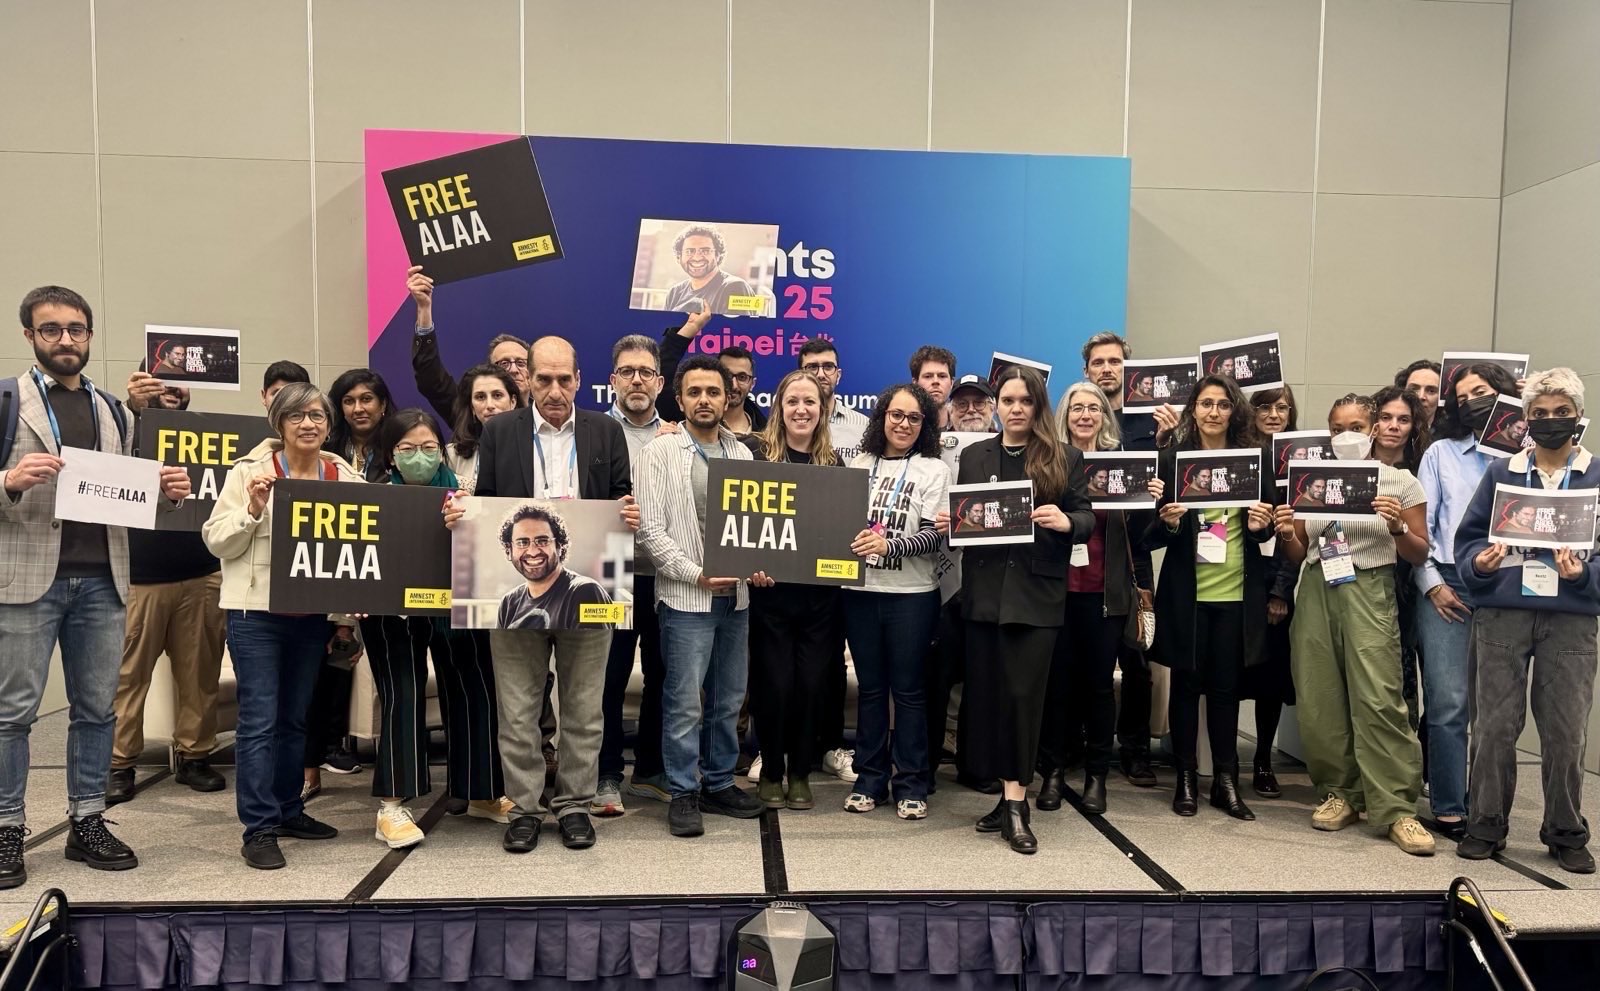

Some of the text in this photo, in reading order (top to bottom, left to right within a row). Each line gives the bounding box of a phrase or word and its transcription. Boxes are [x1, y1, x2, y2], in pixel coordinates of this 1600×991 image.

[402, 173, 478, 221] FREE
[418, 210, 492, 256] ALAA
[783, 284, 834, 320] 25
[591, 384, 618, 404] Th
[157, 429, 240, 466] FREE
[78, 480, 147, 504] #FREEALAA
[722, 478, 797, 515] FREE
[291, 501, 380, 541] FREE
[720, 514, 798, 551] ALAA
[289, 541, 382, 581] ALAA
[409, 592, 436, 600] AMNESTY
